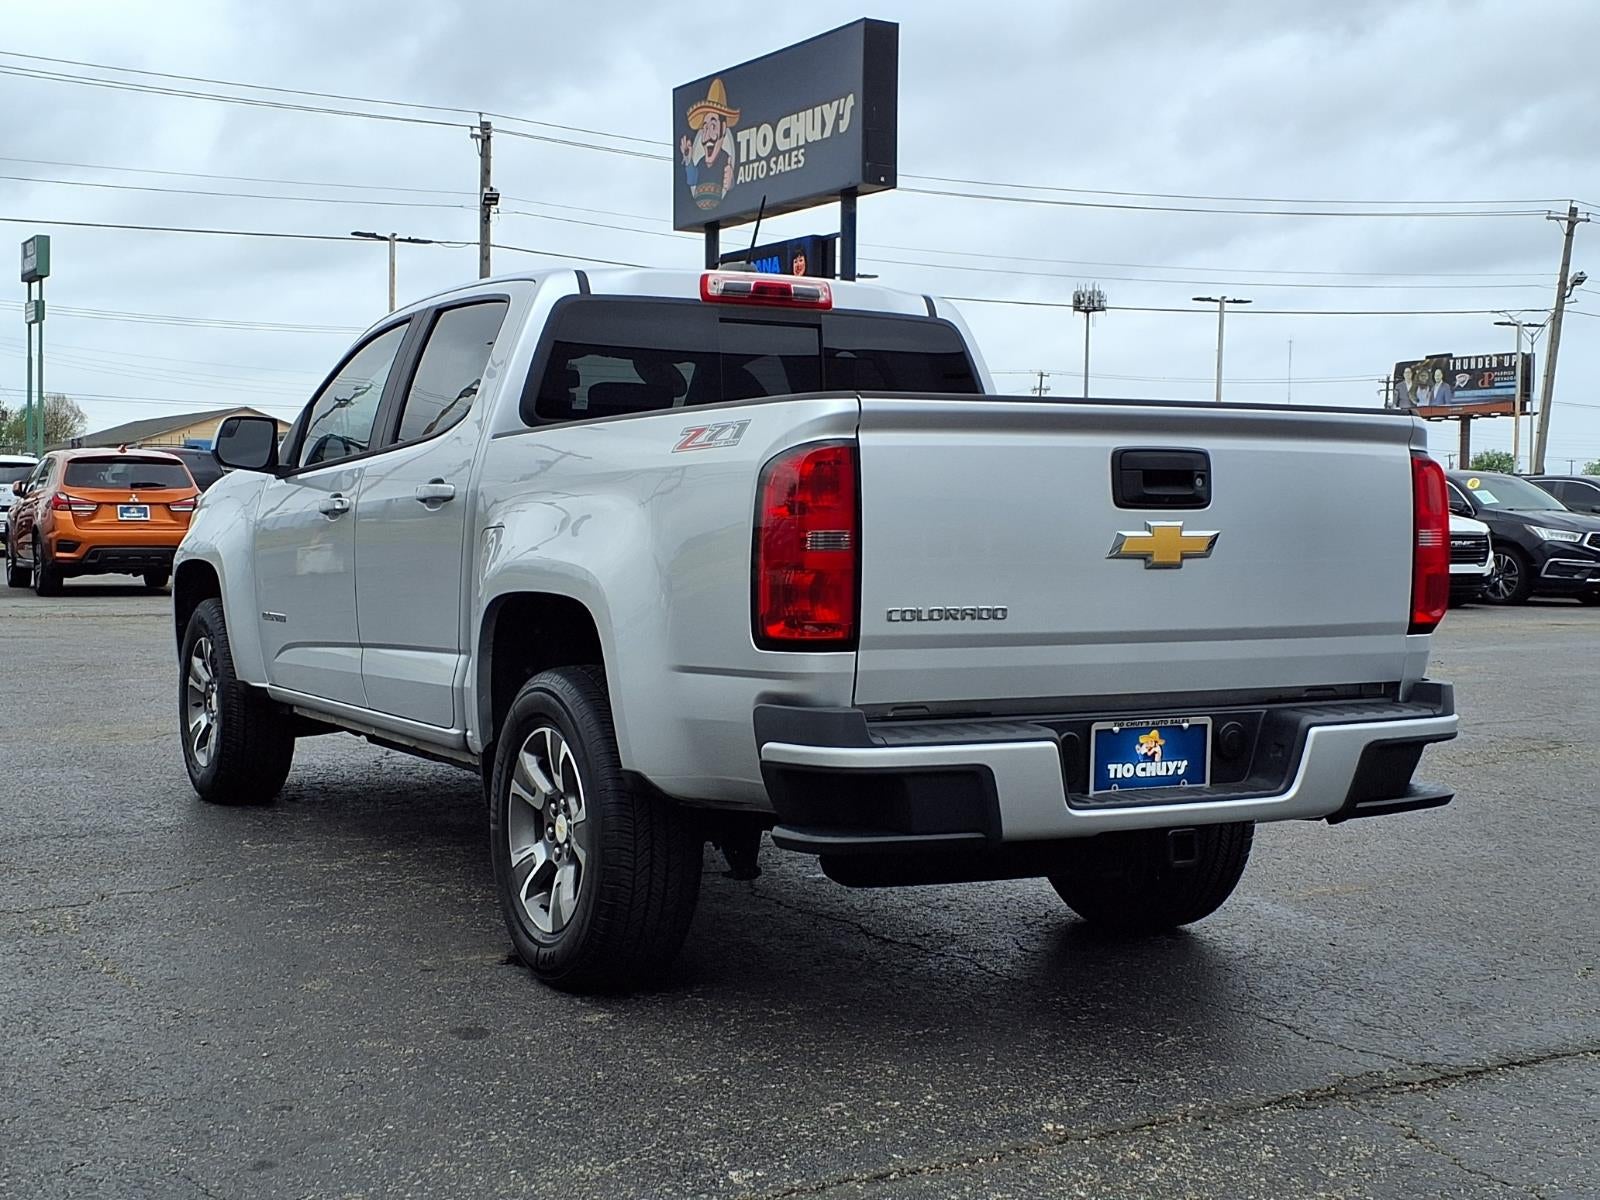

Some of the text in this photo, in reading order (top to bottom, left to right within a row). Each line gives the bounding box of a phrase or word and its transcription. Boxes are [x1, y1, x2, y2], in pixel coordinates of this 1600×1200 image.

[737, 93, 855, 163] TIO CHUY'S
[737, 149, 805, 185] AUTO SALES
[1449, 355, 1517, 371] THUNDER UP
[671, 418, 752, 453] Z71
[886, 605, 1008, 622] COLORADO
[1108, 760, 1187, 778] TIO CHUY'S
